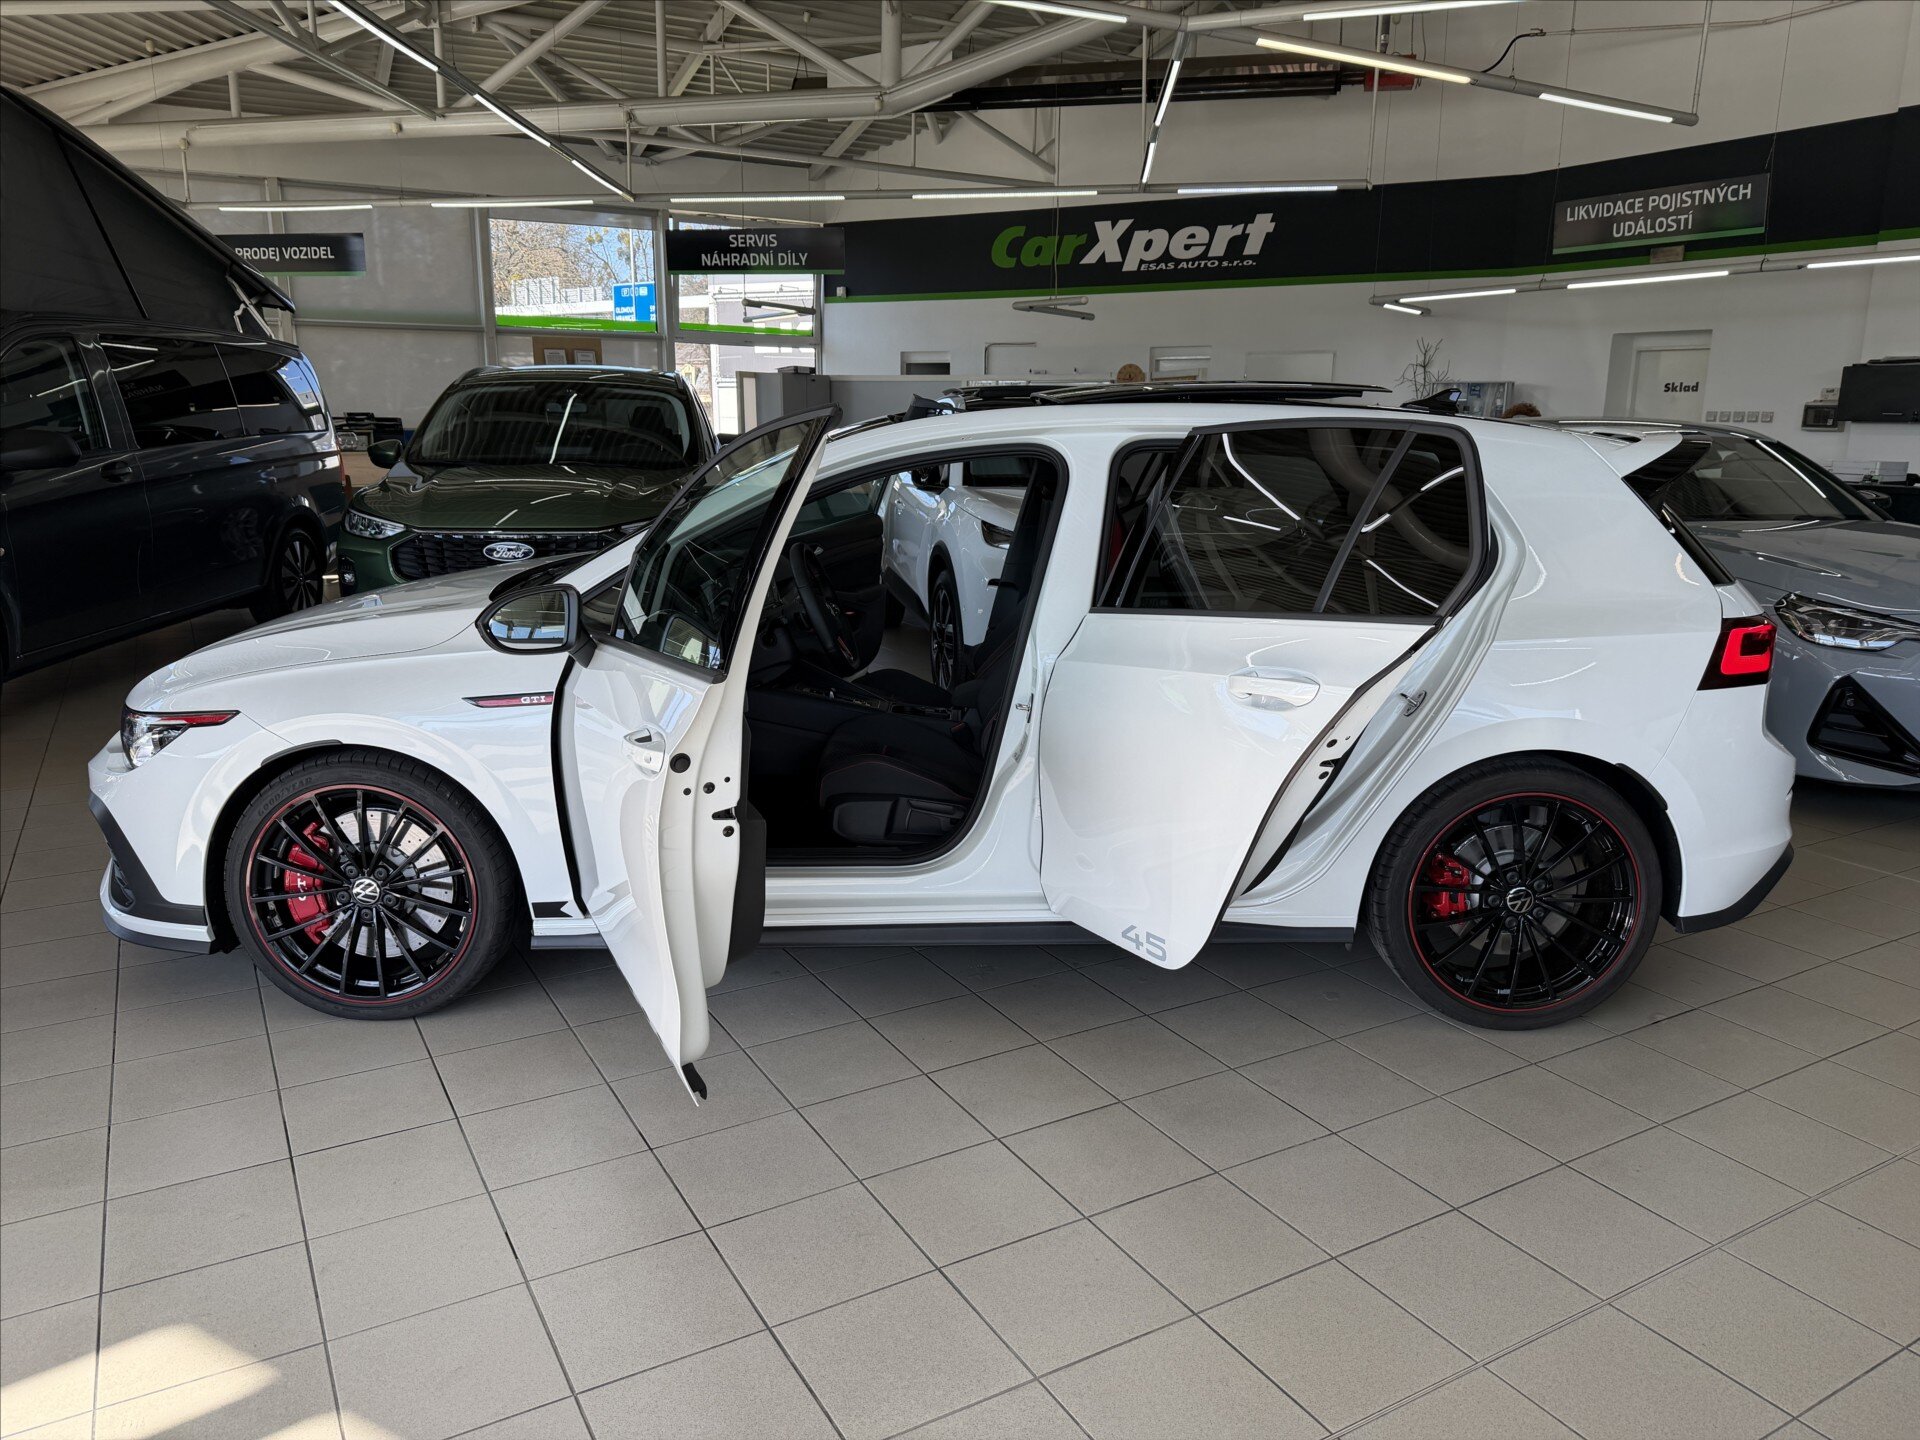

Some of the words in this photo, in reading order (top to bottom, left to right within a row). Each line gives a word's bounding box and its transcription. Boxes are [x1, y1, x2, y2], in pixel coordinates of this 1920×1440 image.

[1566, 197, 1644, 222] LIKVIDACE
[1648, 183, 1752, 212] POJISTNÝCH
[1612, 210, 1694, 238] UDÁLOSTÍ
[728, 234, 778, 248] SERVIS
[990, 212, 1276, 272] CarXpert
[234, 247, 280, 261] PRODEJ
[282, 246, 335, 259] VOZIDEL
[701, 250, 774, 267] NÁHRADNÍ
[778, 250, 808, 266] DÍLY
[1140, 262, 1175, 271] ESAS
[1177, 260, 1218, 269] AUTO
[1221, 259, 1257, 267] s.r.o.
[1663, 381, 1700, 393] Sklad
[493, 544, 529, 558] Ford
[520, 695, 546, 704] GTI
[1121, 924, 1167, 962] 45
